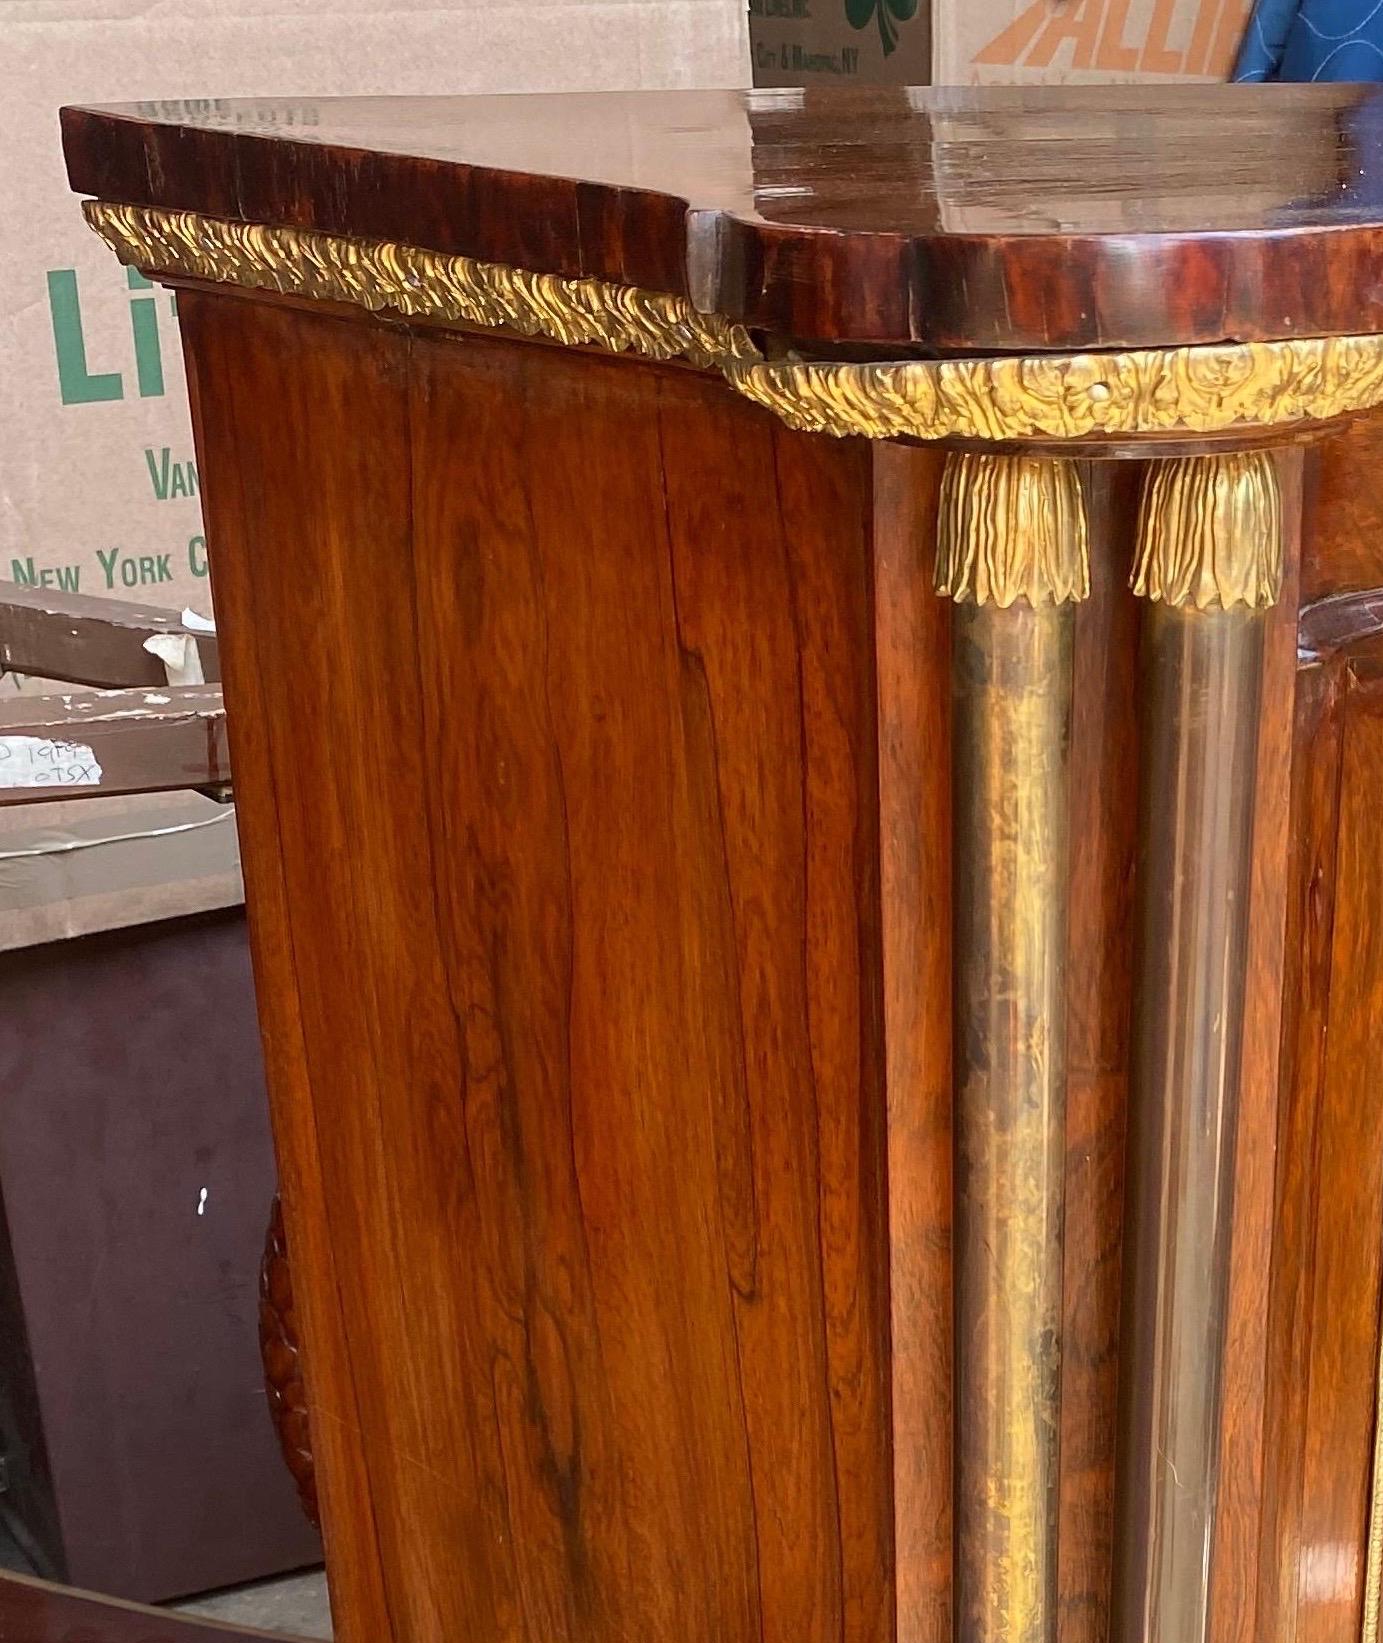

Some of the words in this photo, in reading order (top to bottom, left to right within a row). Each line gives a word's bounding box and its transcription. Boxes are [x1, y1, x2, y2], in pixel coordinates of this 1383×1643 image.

[1022, 0, 1245, 77] ALLI
[47, 264, 177, 405] Li
[11, 557, 81, 592] NEW
[96, 547, 173, 590] YORK
